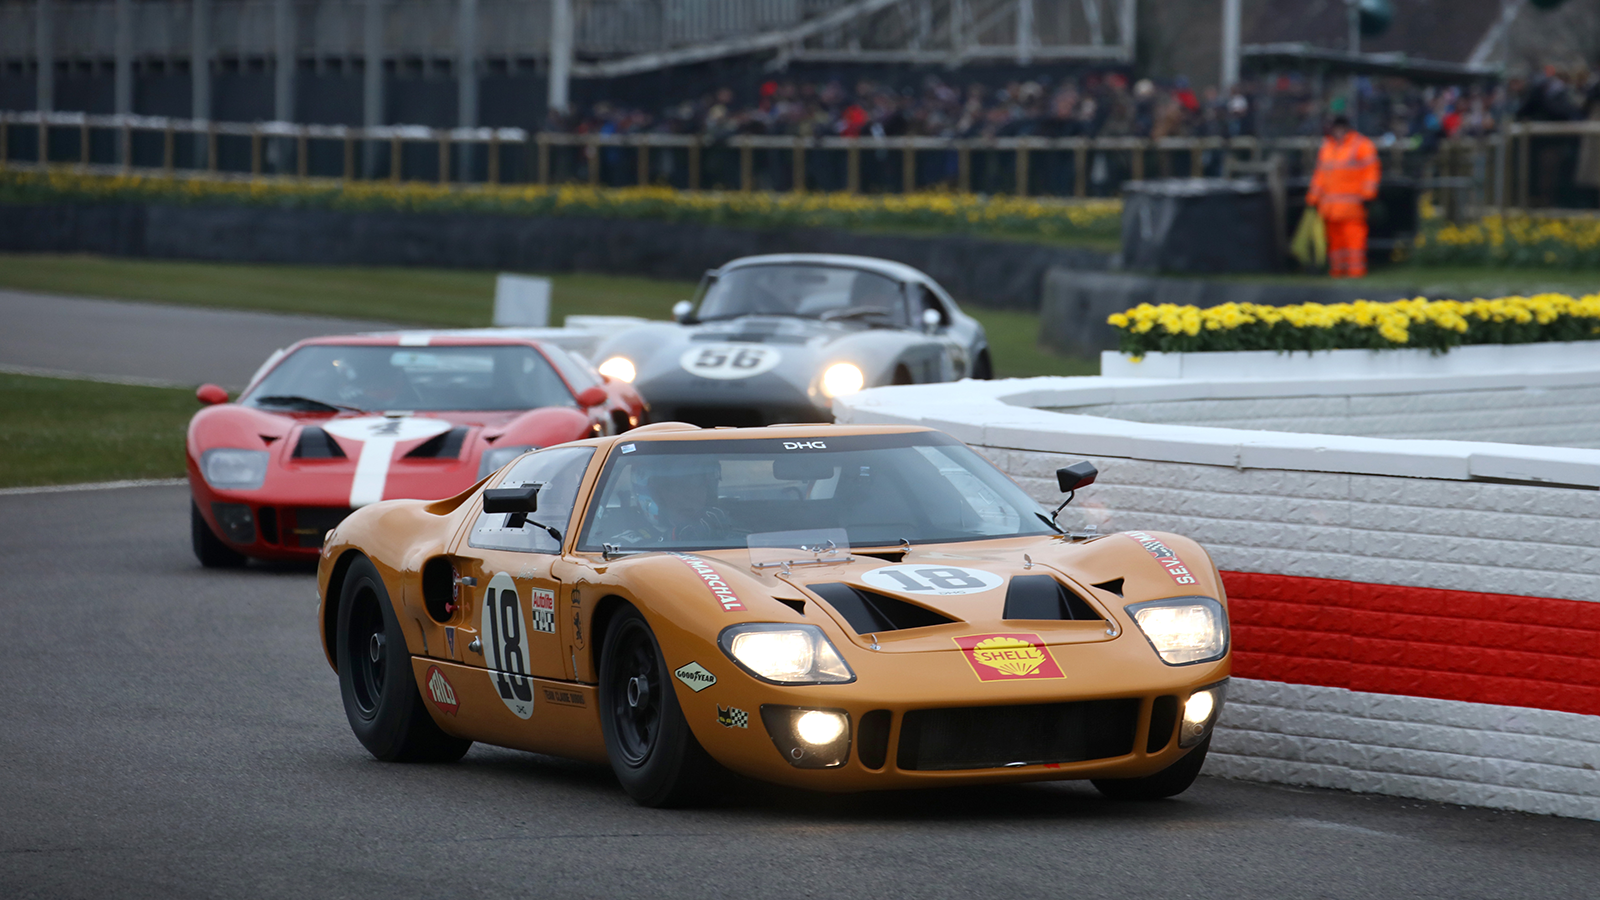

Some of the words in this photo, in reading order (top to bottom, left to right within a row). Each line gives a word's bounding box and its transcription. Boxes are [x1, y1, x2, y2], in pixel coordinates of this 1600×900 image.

[694, 348, 767, 369] 56
[782, 441, 827, 450] DHG
[686, 561, 742, 610] MARCHAL
[878, 568, 987, 591] 18
[533, 591, 553, 610] Autolite
[487, 587, 533, 702] 18
[980, 650, 1038, 662] SHELL
